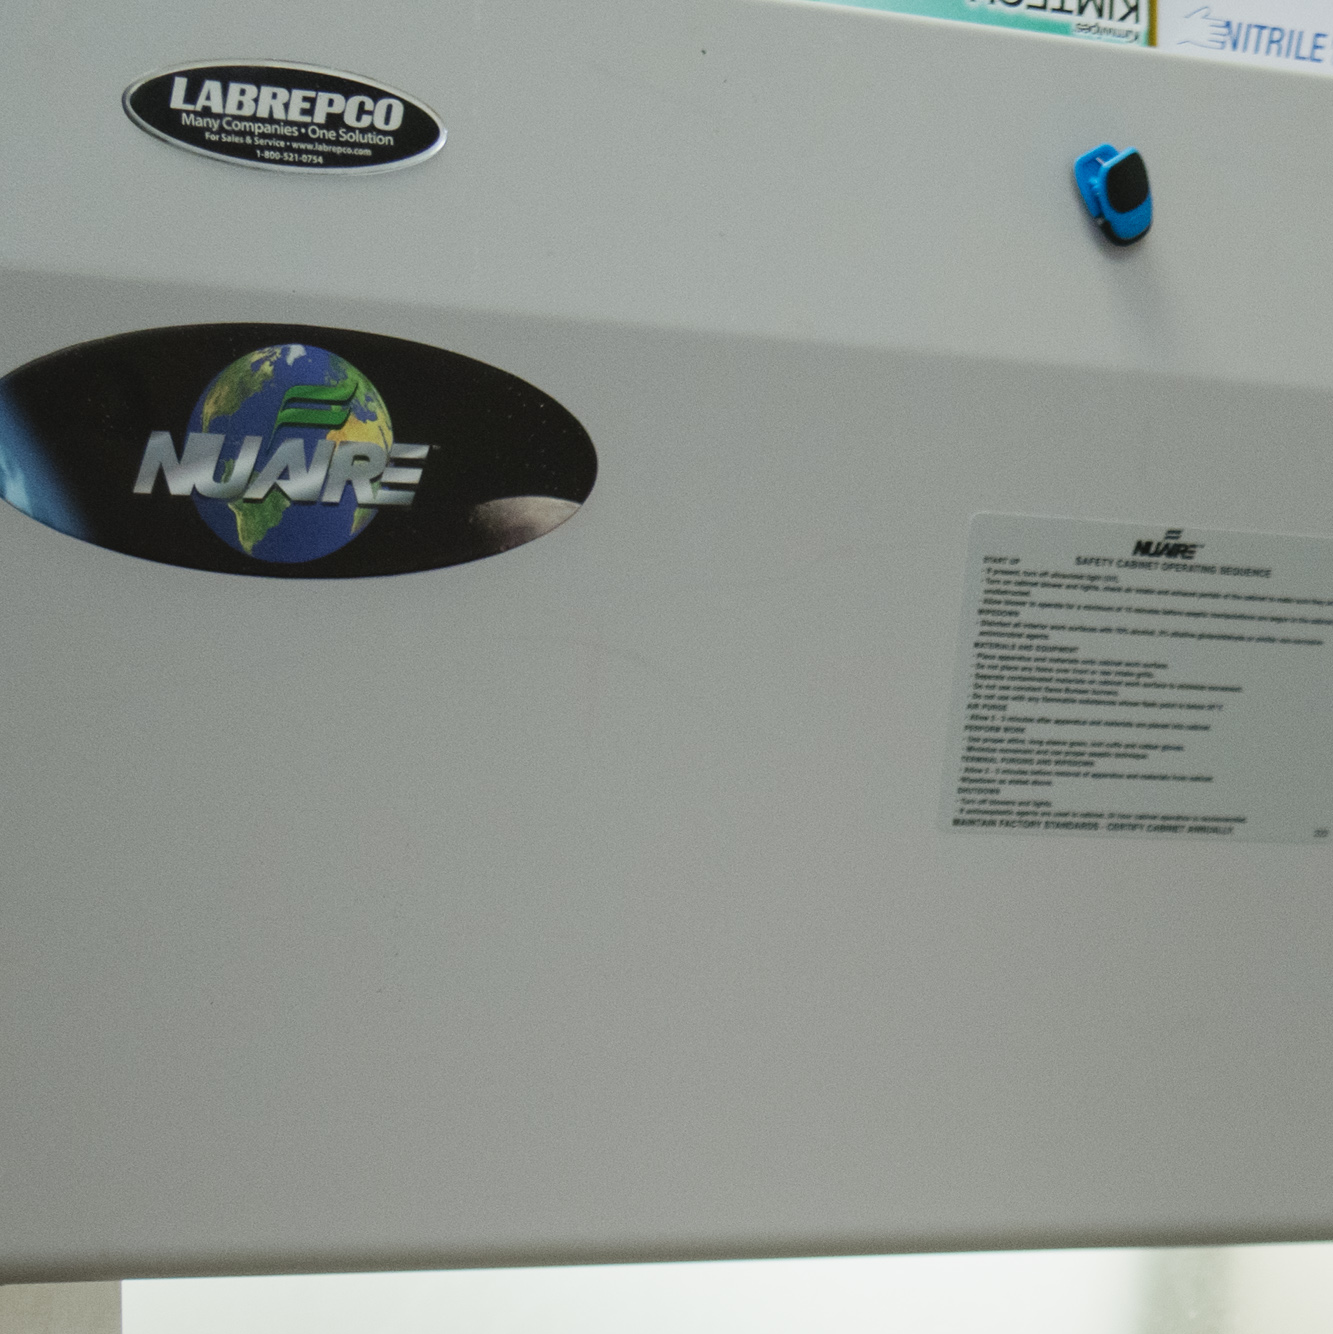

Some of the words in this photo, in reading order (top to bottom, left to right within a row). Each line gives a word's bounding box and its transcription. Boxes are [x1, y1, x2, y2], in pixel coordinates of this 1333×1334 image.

[968, 0, 1140, 24] KIMT
[1224, 20, 1327, 63] NITRILE
[171, 77, 402, 130] LABREPCO
[180, 114, 219, 131] Many
[221, 119, 298, 135] Companies
[307, 126, 335, 139] One
[338, 130, 394, 145] Solution
[220, 133, 243, 143] Sales
[253, 137, 284, 147] Service
[291, 141, 372, 155] www.labrepco.com
[133, 430, 431, 508] NUAIRE
[1074, 556, 1112, 566] SAFETY
[1116, 558, 1157, 570] CABINET
[1161, 562, 1216, 574] OPERATING
[1219, 565, 1272, 578] SEQUENCE
[951, 818, 996, 827] MAINTAIN
[999, 819, 1040, 828] FACTORY
